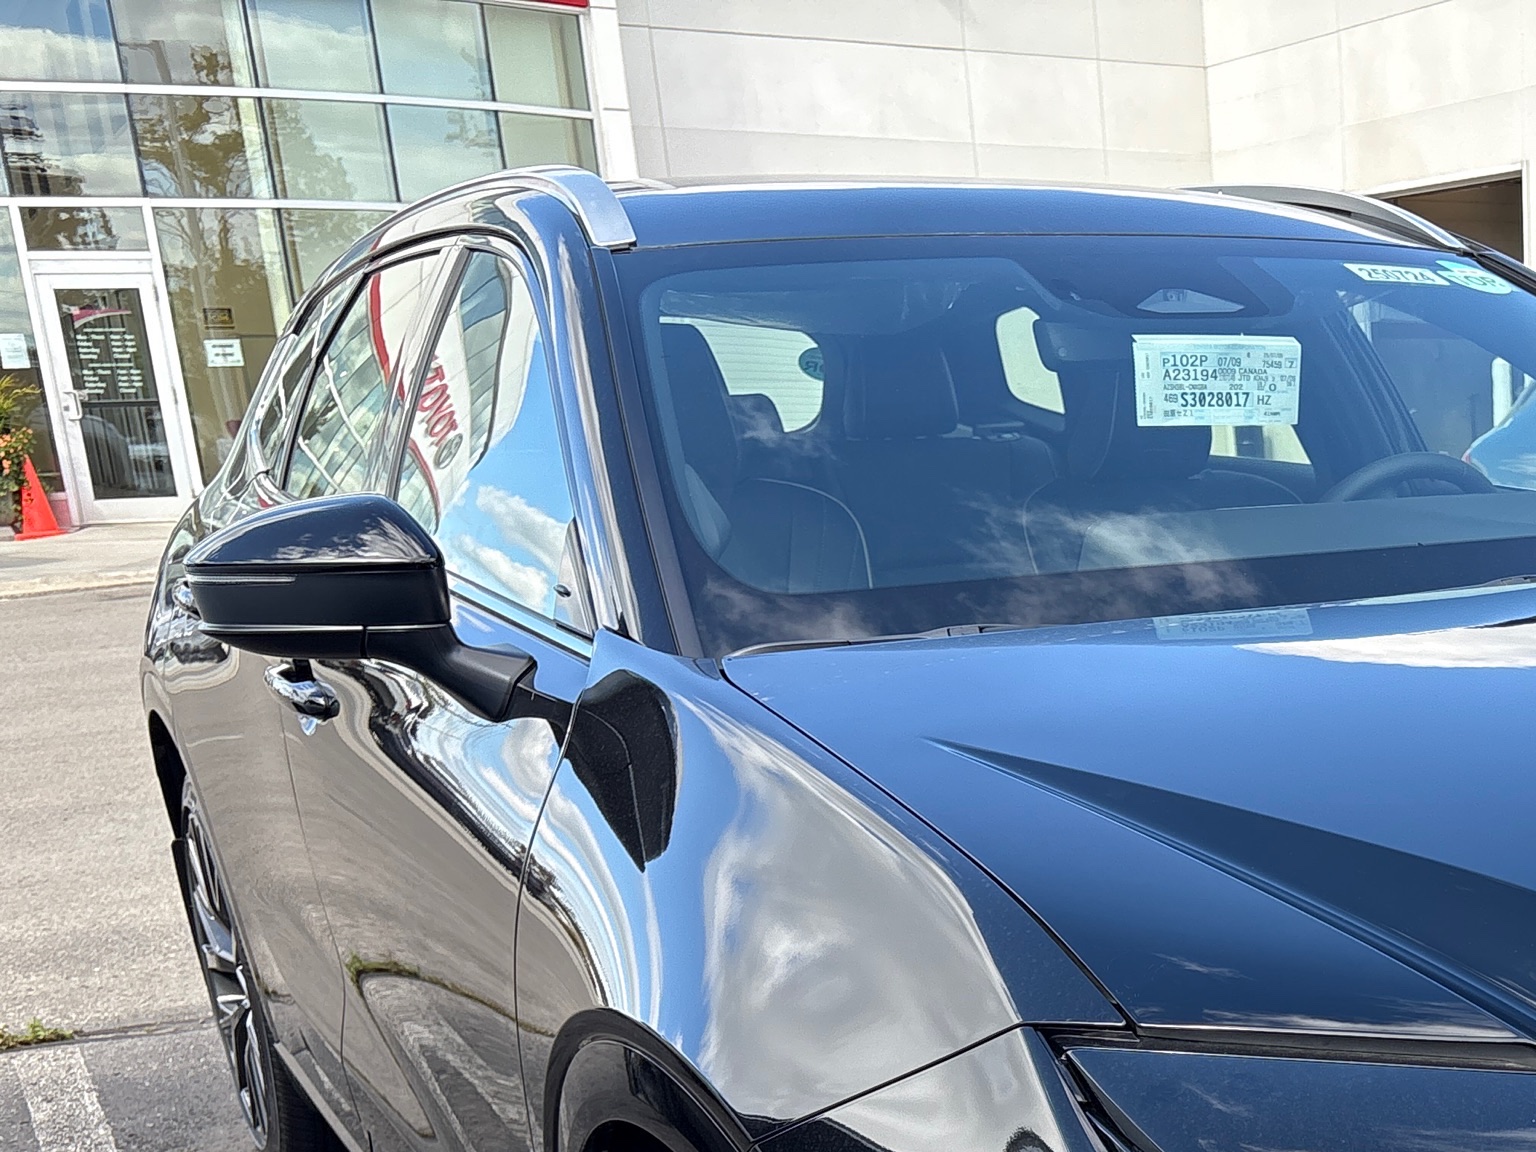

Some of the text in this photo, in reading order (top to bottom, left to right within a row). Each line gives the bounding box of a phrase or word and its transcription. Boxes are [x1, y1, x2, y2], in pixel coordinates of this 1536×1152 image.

[1162, 369, 1218, 381] A23194
[1180, 392, 1250, 408] S3028017
[1257, 395, 1272, 406] HZ
